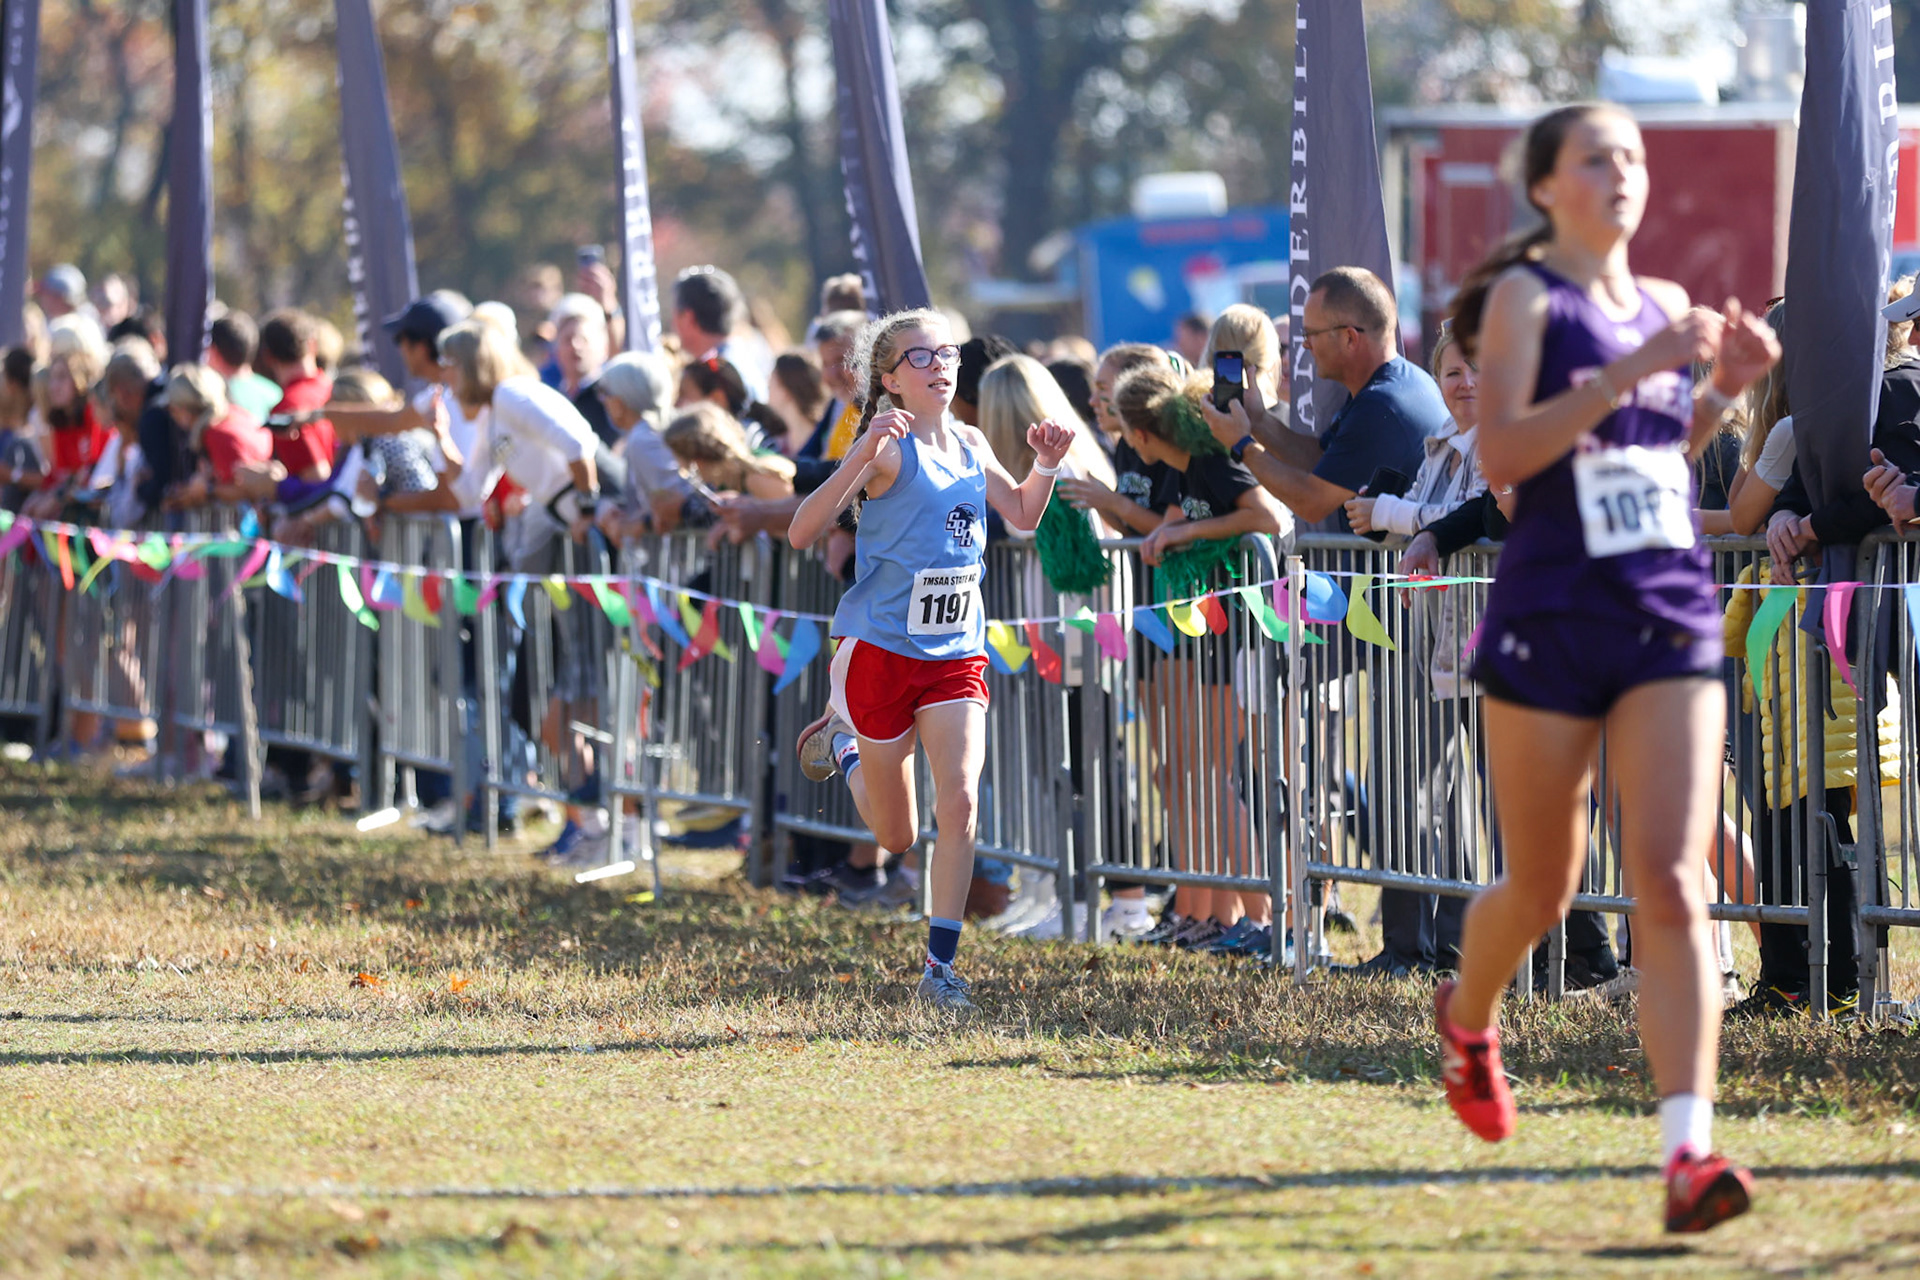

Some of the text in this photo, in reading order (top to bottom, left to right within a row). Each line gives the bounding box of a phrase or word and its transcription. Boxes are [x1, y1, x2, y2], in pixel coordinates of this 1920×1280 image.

[923, 576, 949, 586] TMSAA
[950, 574, 968, 586] STATE
[920, 590, 971, 624] 1197
